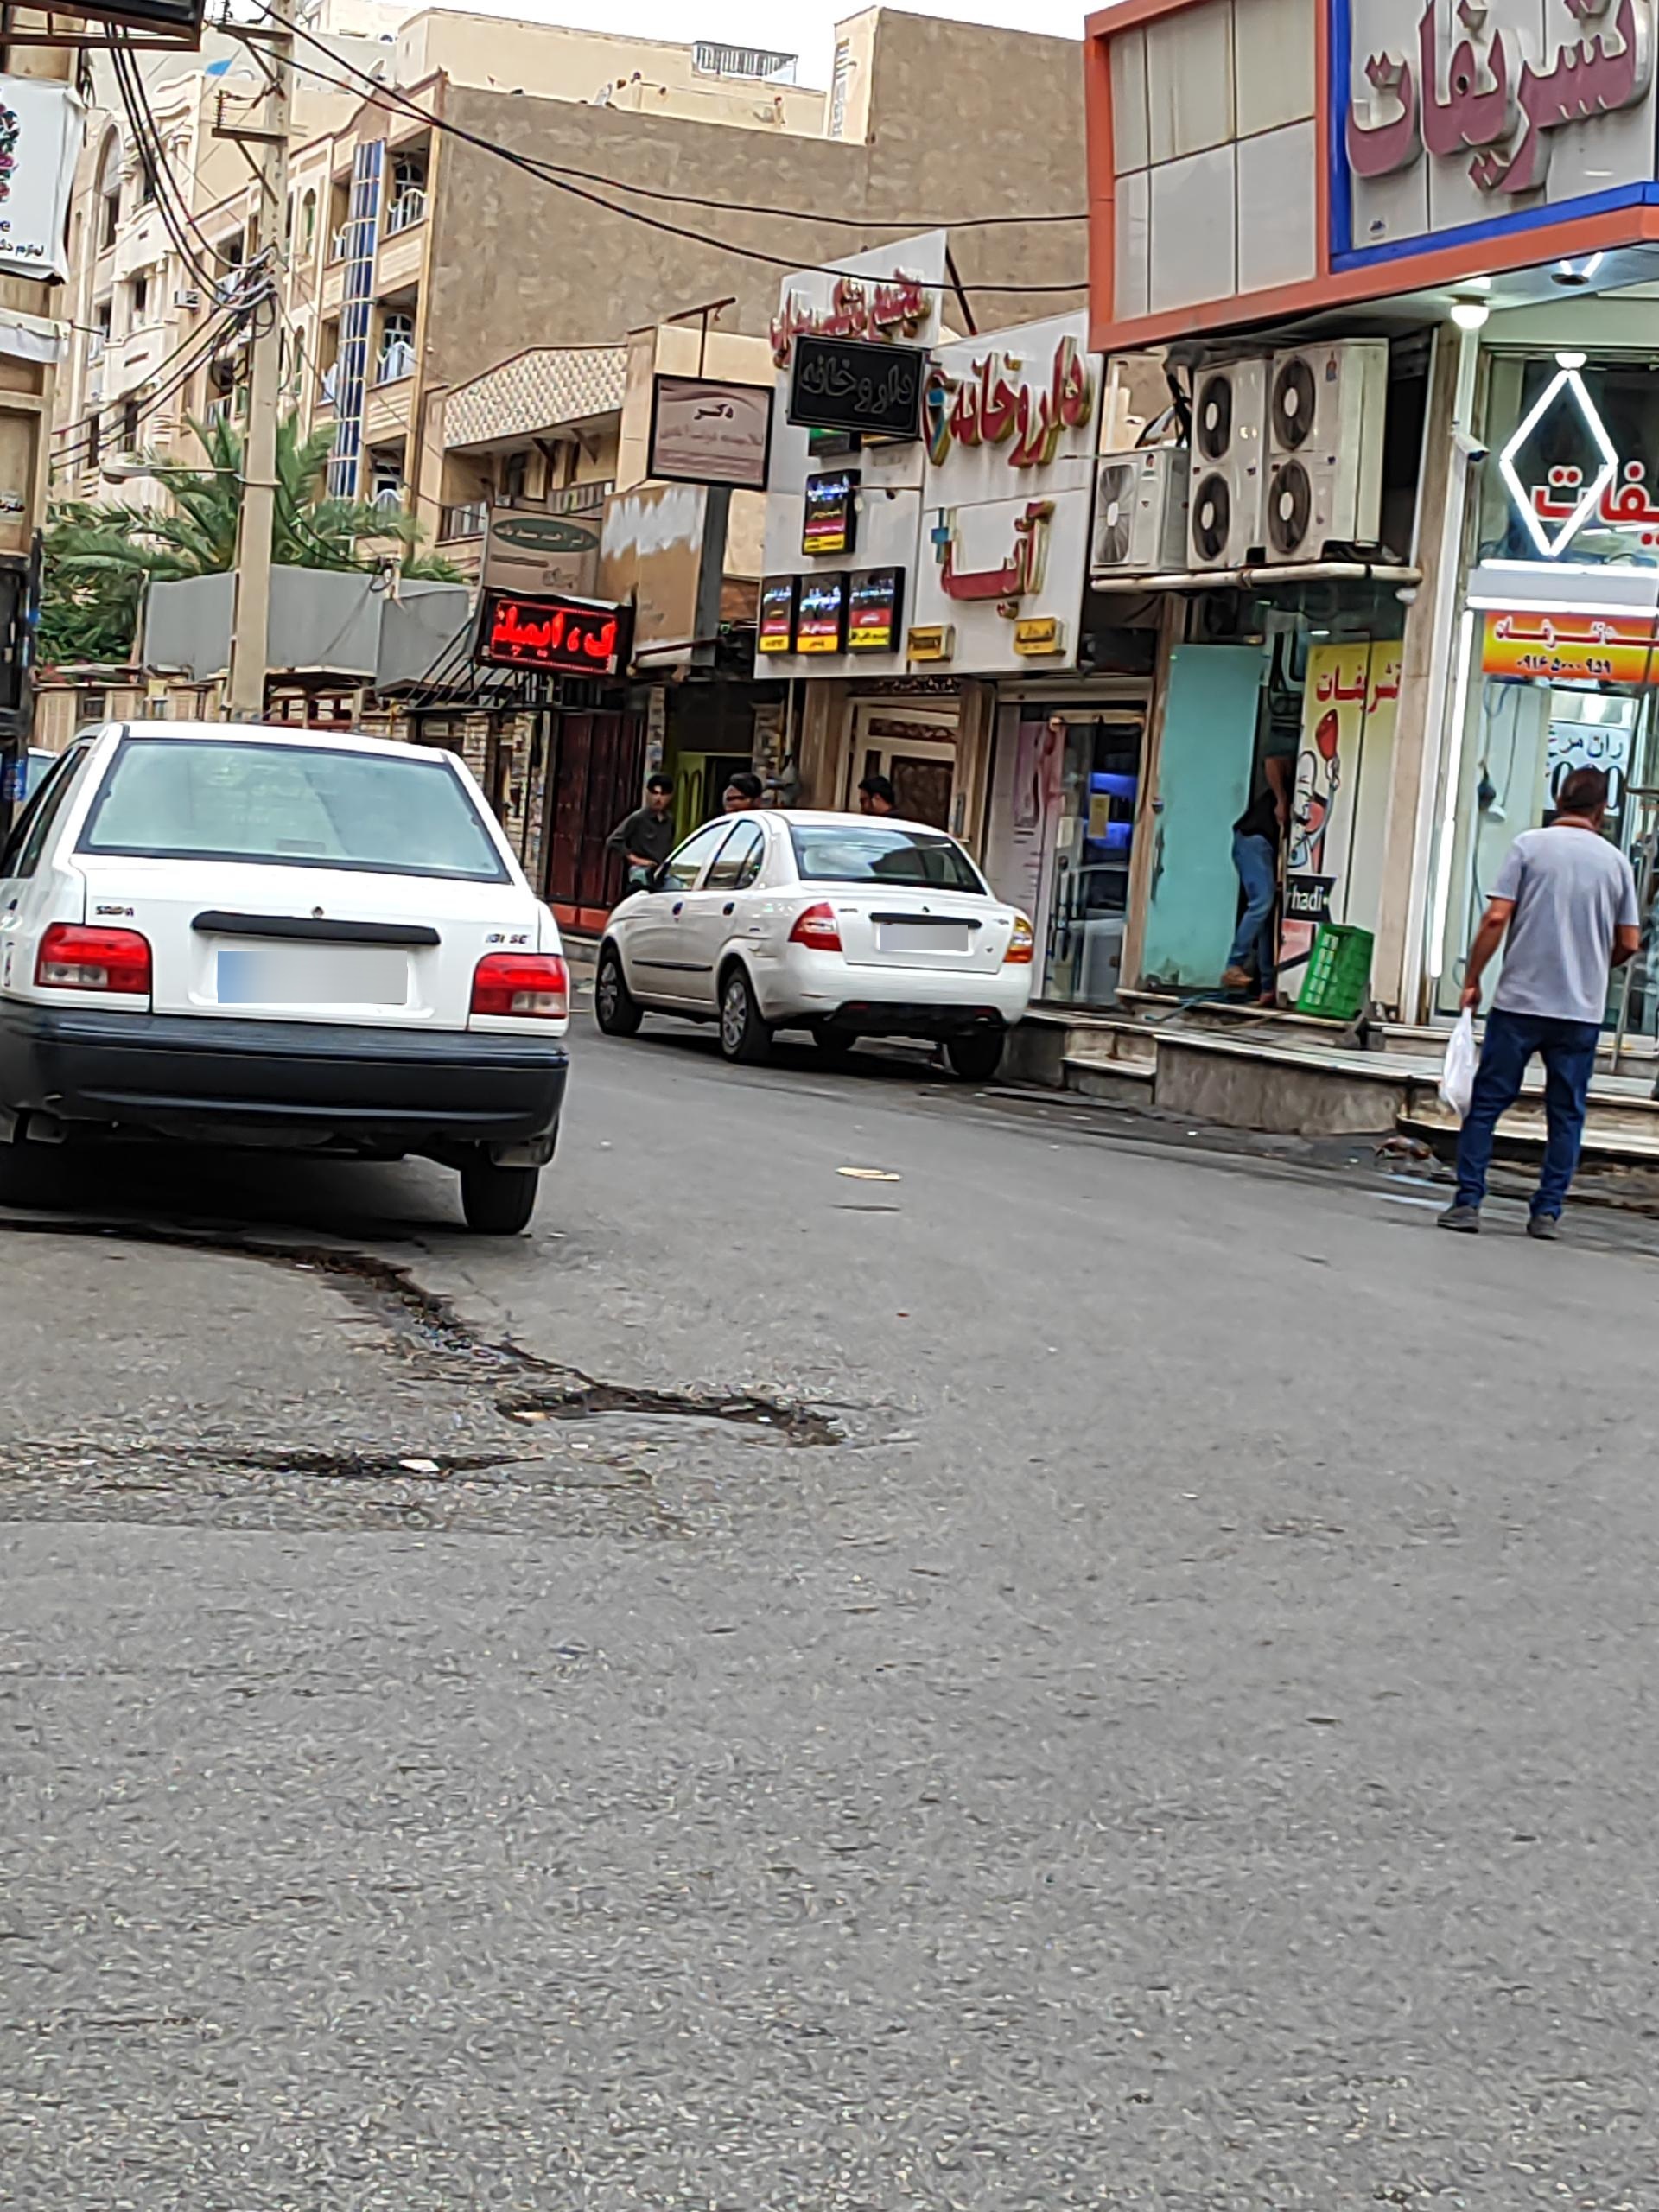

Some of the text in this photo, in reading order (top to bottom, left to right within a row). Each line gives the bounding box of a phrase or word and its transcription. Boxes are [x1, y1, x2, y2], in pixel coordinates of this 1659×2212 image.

[801, 355, 913, 414] داروخانه
[950, 335, 1090, 470] داروخانه
[1587, 733, 1623, 759] ران
